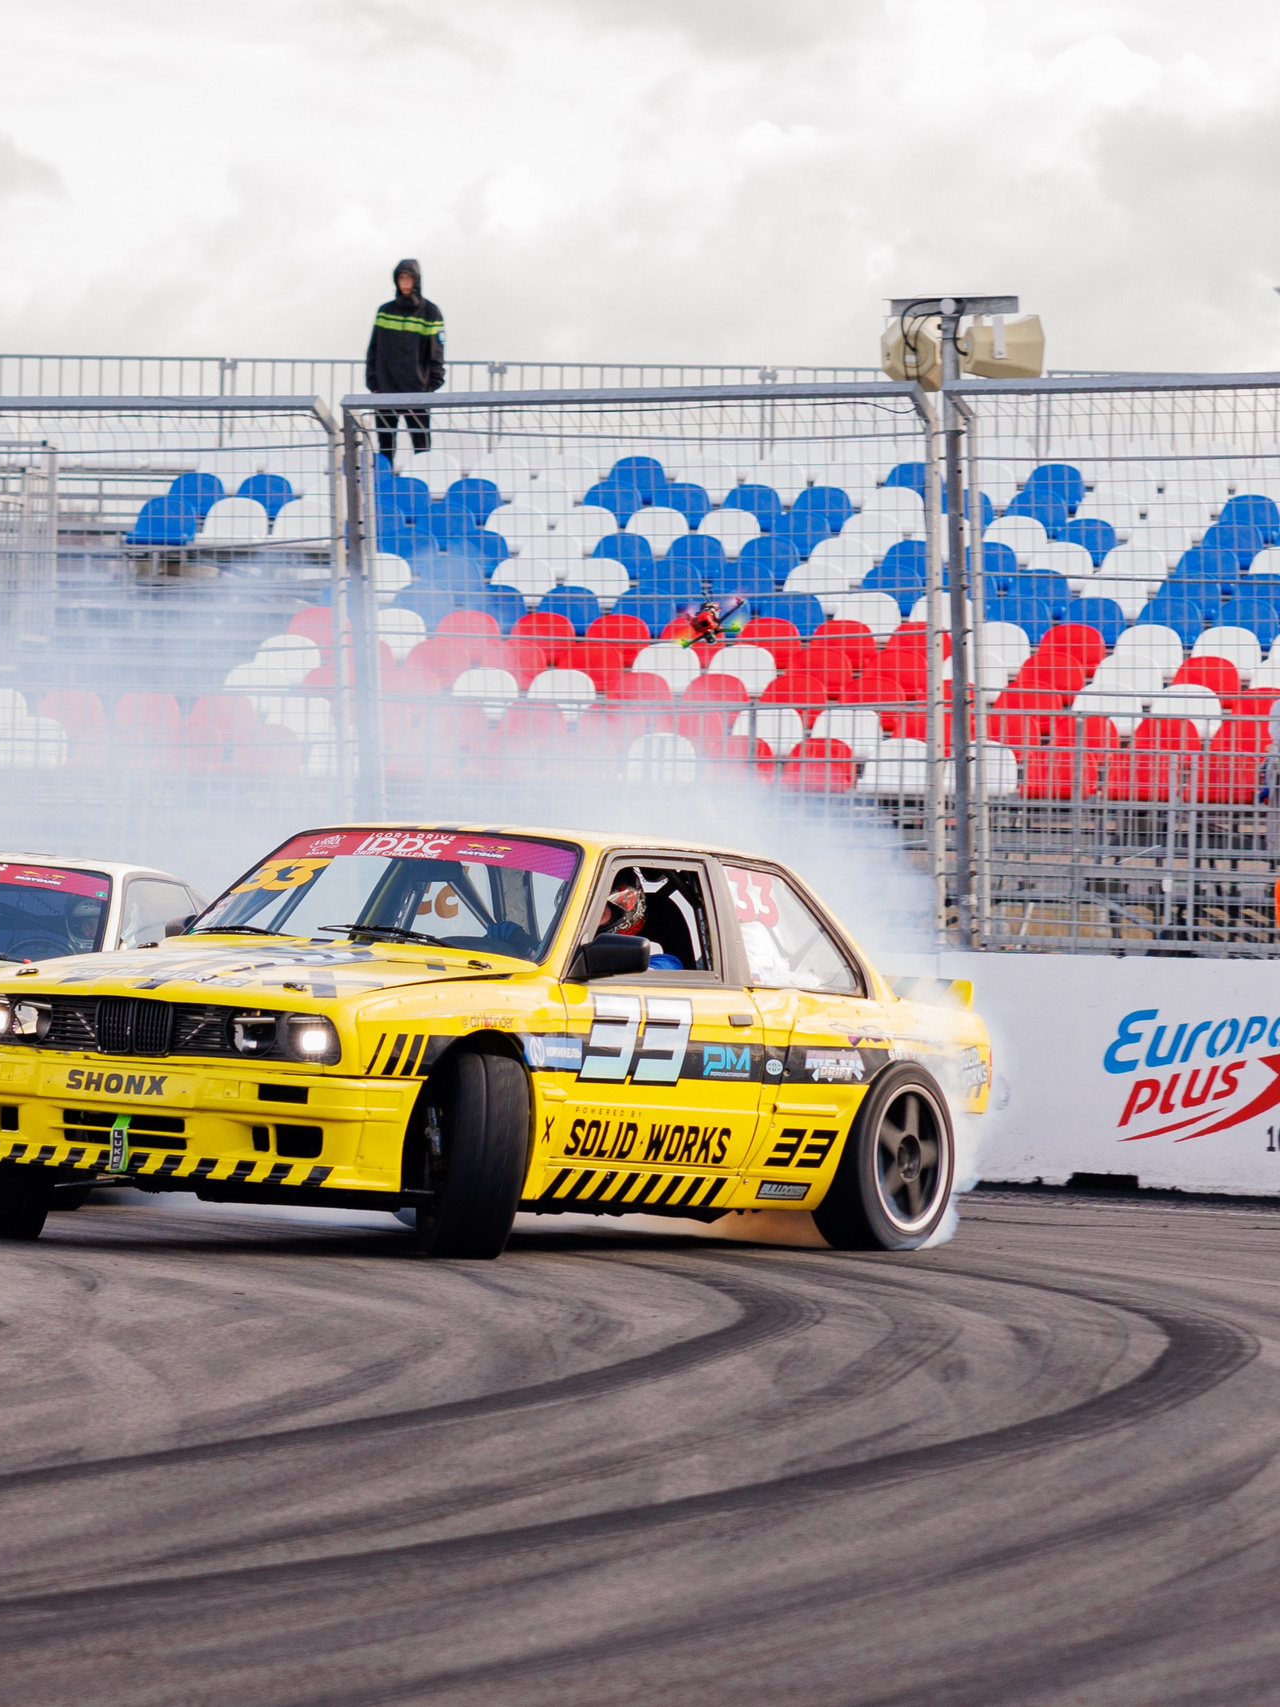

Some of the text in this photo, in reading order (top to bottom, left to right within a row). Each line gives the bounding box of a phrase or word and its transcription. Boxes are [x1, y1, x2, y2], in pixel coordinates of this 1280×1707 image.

[357, 837, 451, 854] IDDC
[371, 832, 457, 842] IGORA DRIVE
[381, 850, 440, 860] CHALLENGE
[229, 858, 334, 894] 33
[725, 868, 779, 928] 33
[577, 993, 693, 1087] 33
[65, 1069, 168, 1095] SHONX
[575, 1106, 625, 1117] POWERED
[563, 1118, 732, 1164] SOLID WORKS
[763, 1128, 839, 1168] 33
[1266, 1125, 1280, 1152] 1
